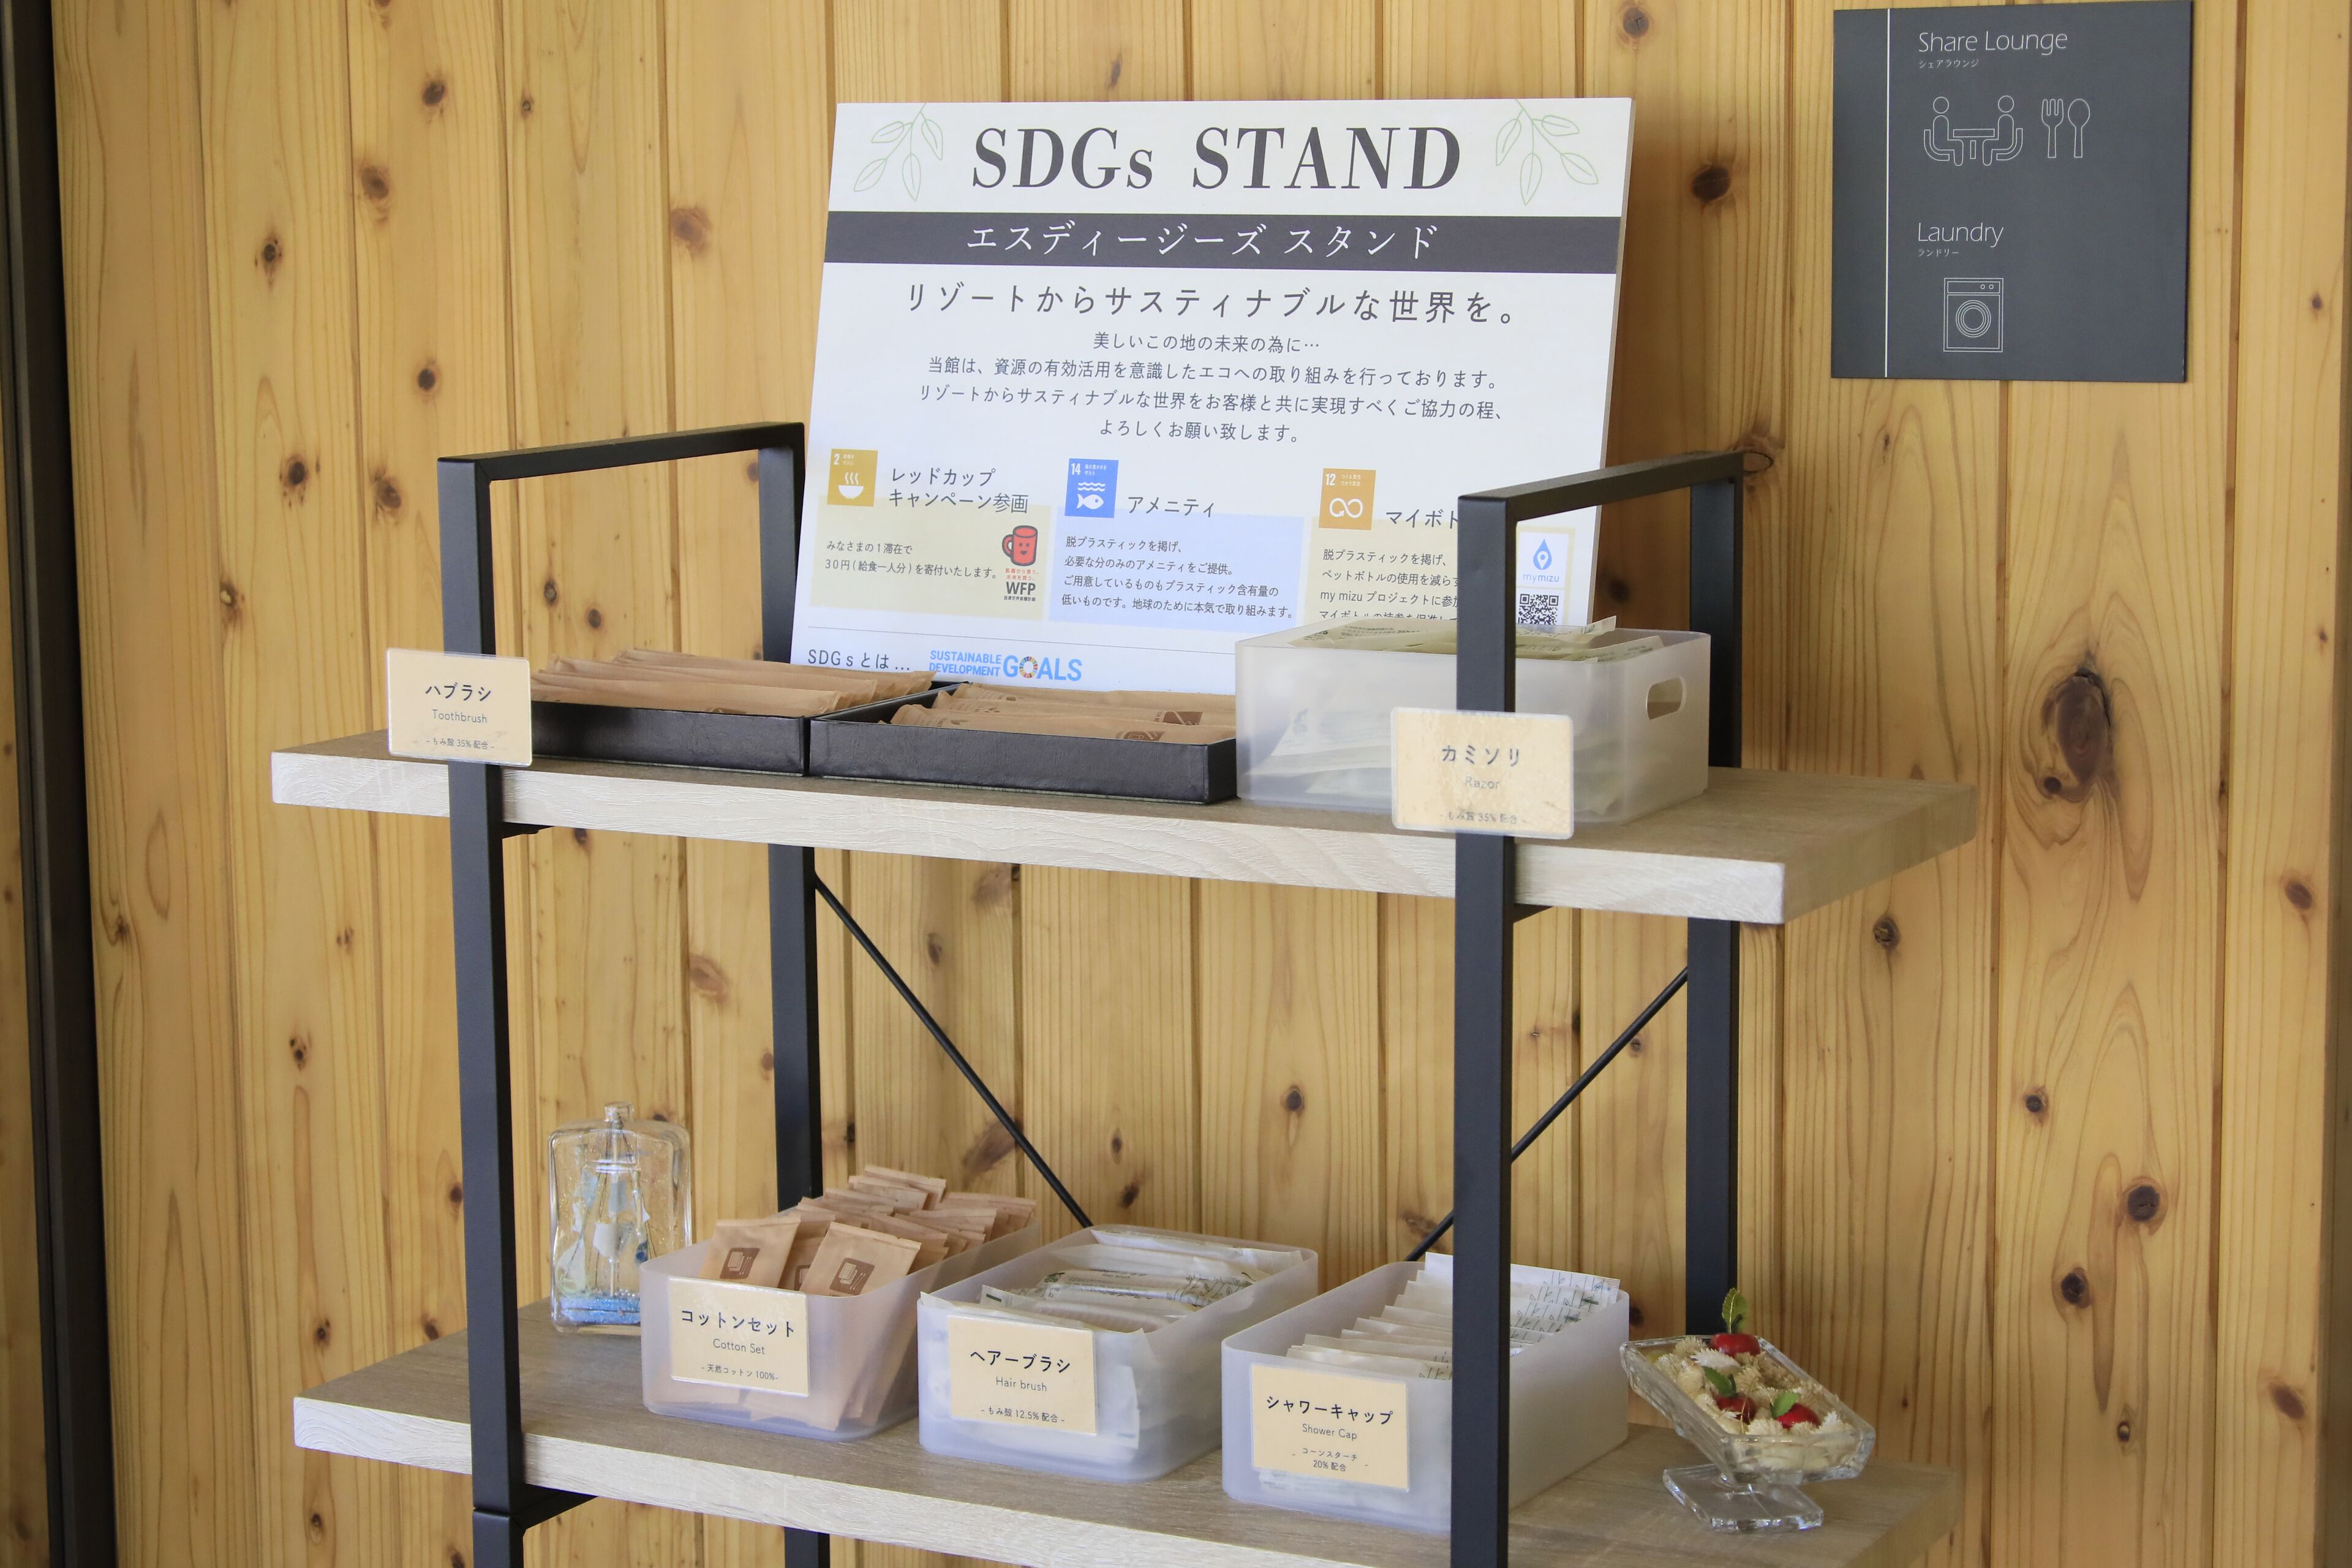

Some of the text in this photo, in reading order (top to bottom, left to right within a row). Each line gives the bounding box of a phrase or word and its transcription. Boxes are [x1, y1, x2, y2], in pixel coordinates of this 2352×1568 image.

[1919, 31, 2067, 55] Share Lounge
[1920, 59, 1978, 68] シェアラウンジ
[973, 127, 1460, 189] SDGs STAND
[968, 222, 1437, 259] エスディージーズ スタンド
[1918, 223, 2003, 247] Laundry
[911, 282, 1510, 323] リゾートからサスティナブルな世界を。
[1101, 420, 1296, 442] よろしくお願い致します。
[833, 453, 841, 465] 2
[893, 468, 995, 486] レッドカップ
[1070, 462, 1082, 477] 14
[1325, 473, 1335, 485] 12
[889, 489, 1028, 513] キャンペーン参画
[1128, 497, 1213, 518] アメニティ
[1066, 537, 1181, 552] 脱プラスティックを掲げ、
[1065, 556, 1232, 575] 必要な分のみのアメニティをご提供。
[1323, 549, 1446, 566] 脱プラスティックを掲げ、
[1006, 582, 1036, 595] WFP
[1065, 575, 1278, 597] ご用意しているものもプラスティック含有量の
[1339, 591, 1362, 601] mizu
[930, 650, 1003, 666] SUSTAINABLE
[929, 655, 1082, 683] DEVELOPMENT GOALS
[426, 682, 491, 701] ハブラシ
[432, 709, 486, 723] Toothbrush
[1442, 745, 1518, 766] カミソリ
[1465, 775, 1499, 789] Razor
[682, 1311, 793, 1337] コットンセット
[713, 1338, 764, 1354] Cotton Set
[707, 1364, 752, 1376] 天然コットン
[971, 1351, 1070, 1373] ヘアーブラシ
[997, 1377, 1046, 1392] Hair brush
[1016, 1410, 1039, 1420] 12.5%
[1267, 1396, 1393, 1424] シャワーキャップ
[1303, 1423, 1357, 1441] Shower Cap
[1303, 1448, 1357, 1461] コーンスターチ
[1313, 1460, 1328, 1469] 20%
